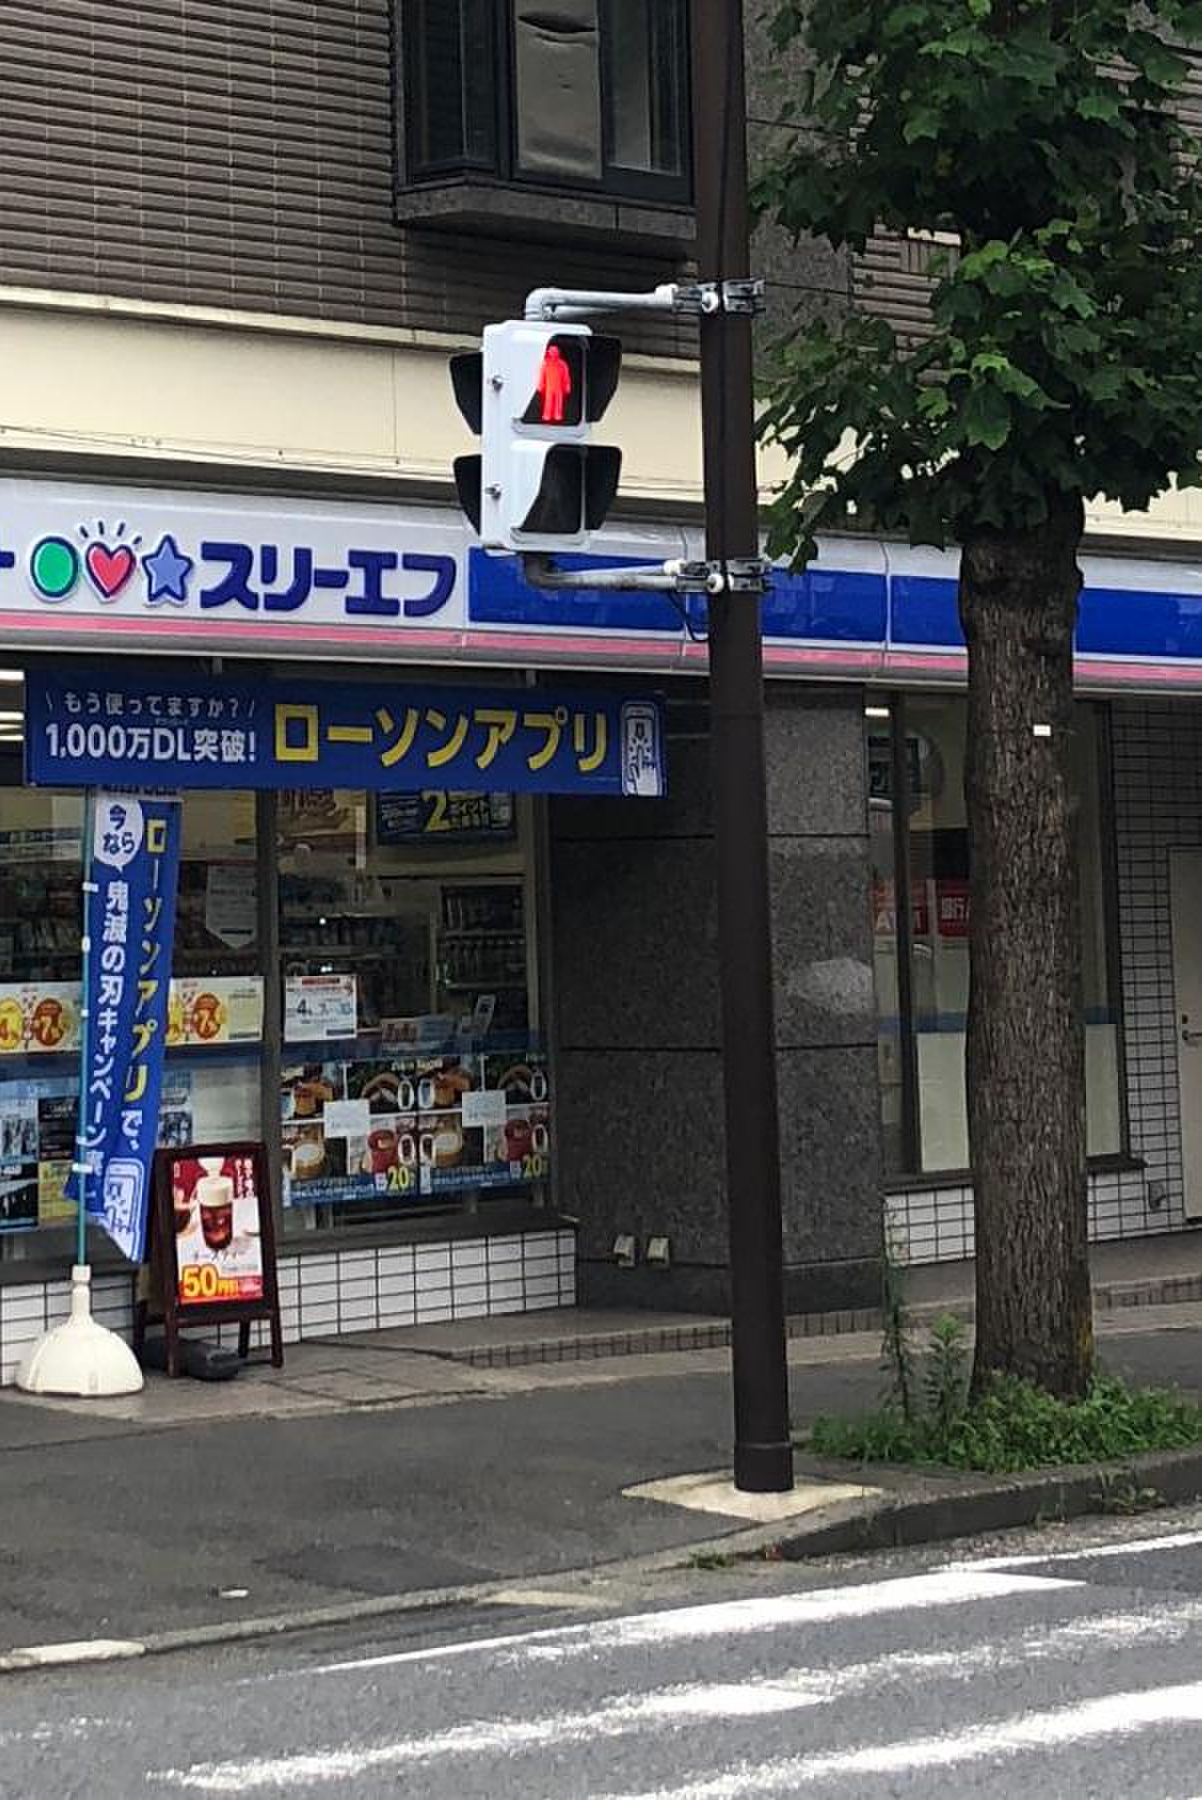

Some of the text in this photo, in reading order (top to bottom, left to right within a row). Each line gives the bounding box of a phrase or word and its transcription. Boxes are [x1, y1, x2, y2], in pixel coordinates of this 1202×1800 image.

[200, 541, 458, 618] スリーエフ
[274, 702, 607, 772] ローソンアプリ
